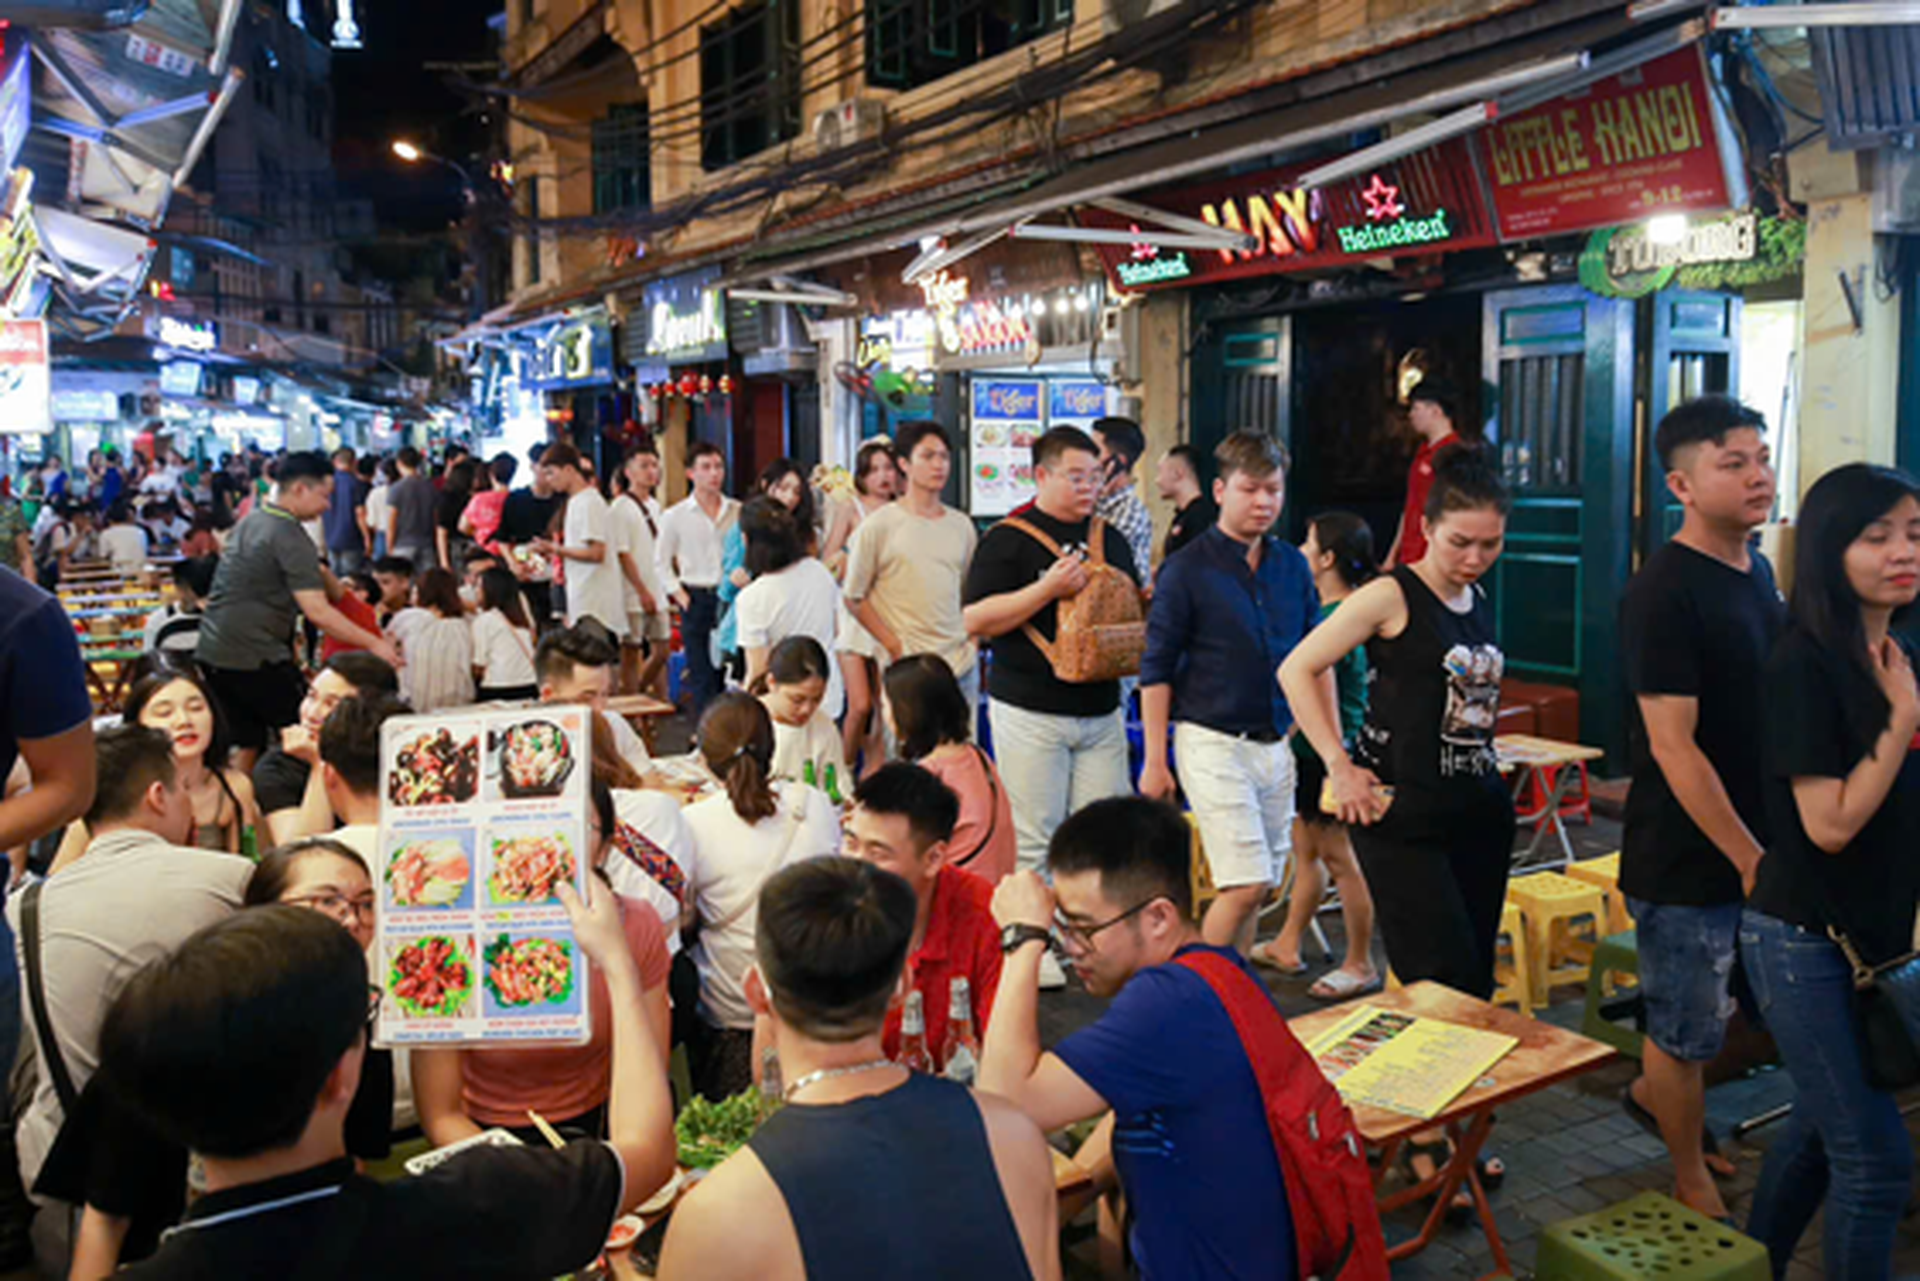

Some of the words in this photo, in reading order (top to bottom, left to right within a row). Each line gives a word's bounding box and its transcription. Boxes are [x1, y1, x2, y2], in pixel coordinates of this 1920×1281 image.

[1488, 110, 1589, 185] LITTLE
[1593, 84, 1701, 163] HANOI
[1337, 208, 1450, 253] Heineken
[989, 388, 1036, 415] Tiger
[1062, 389, 1105, 415] Tiger
